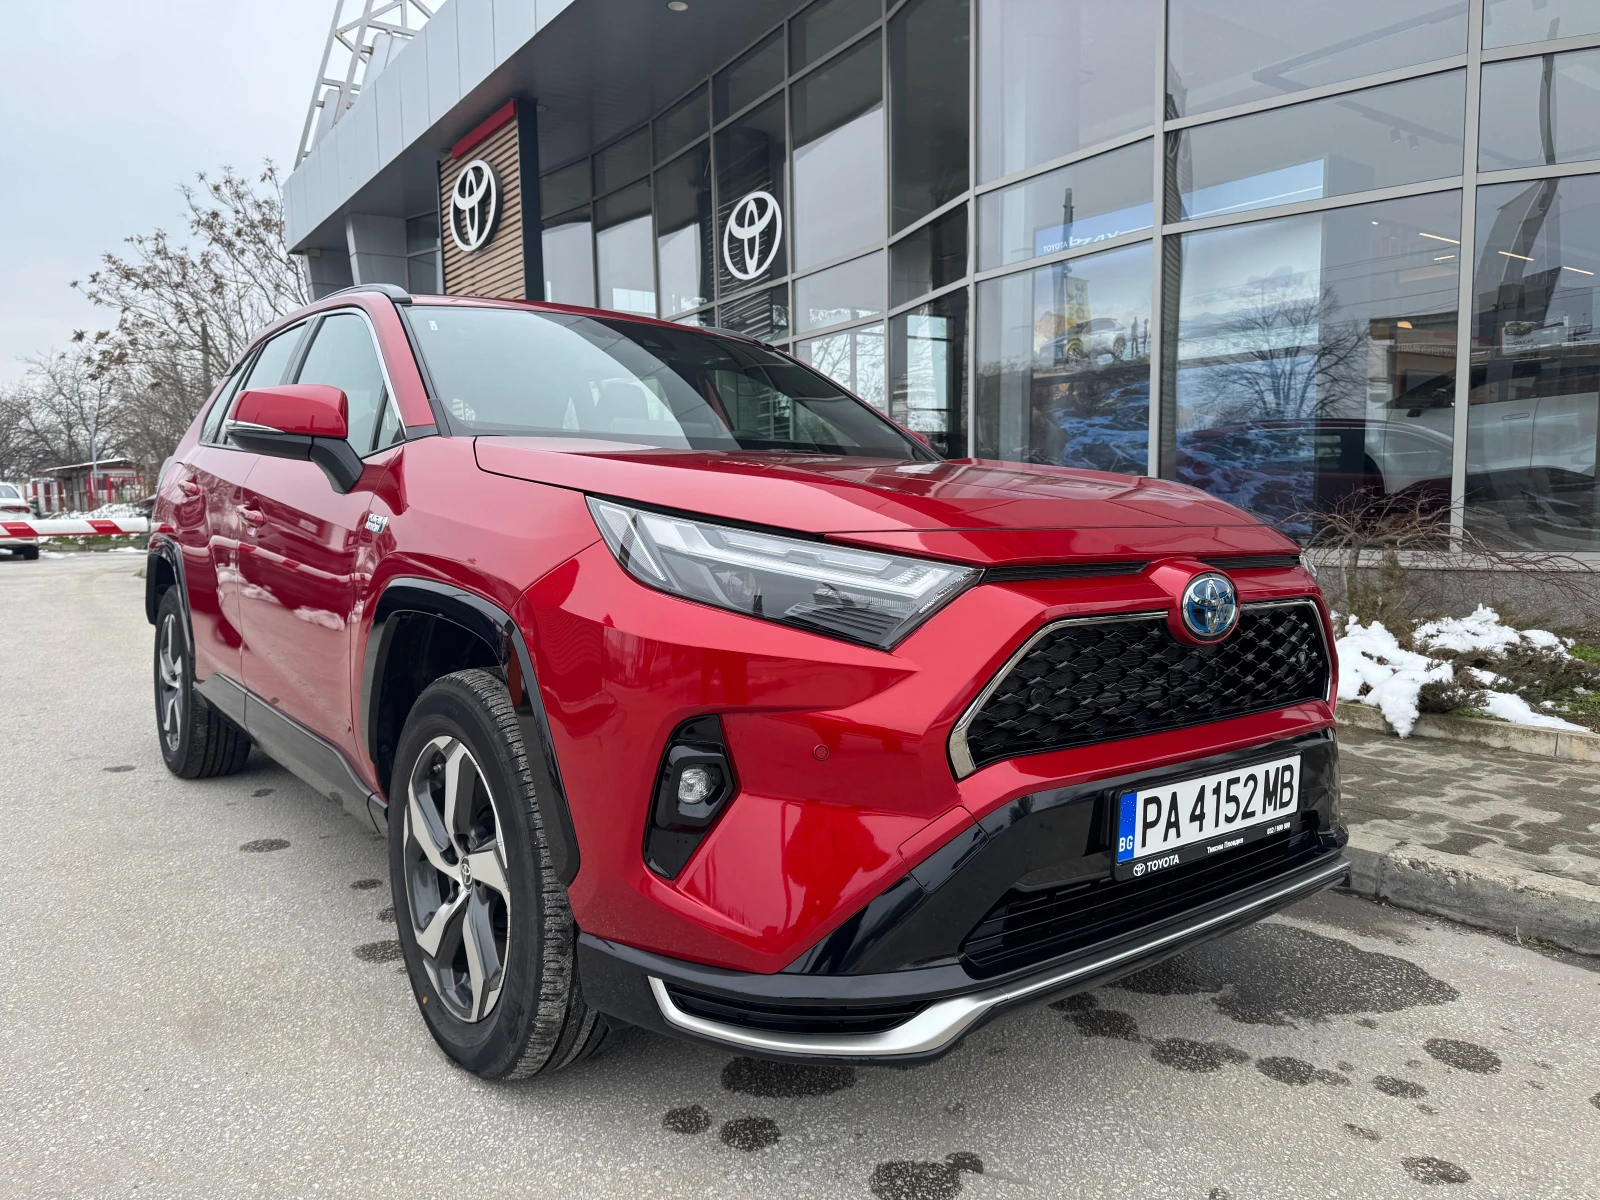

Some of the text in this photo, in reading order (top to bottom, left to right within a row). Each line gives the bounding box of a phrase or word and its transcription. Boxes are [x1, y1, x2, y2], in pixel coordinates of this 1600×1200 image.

[1043, 241, 1068, 253] TOYOTA
[1141, 764, 1295, 848] PA 4152 MB
[1118, 836, 1134, 853] BG
[1146, 854, 1180, 873] TOYOTA
